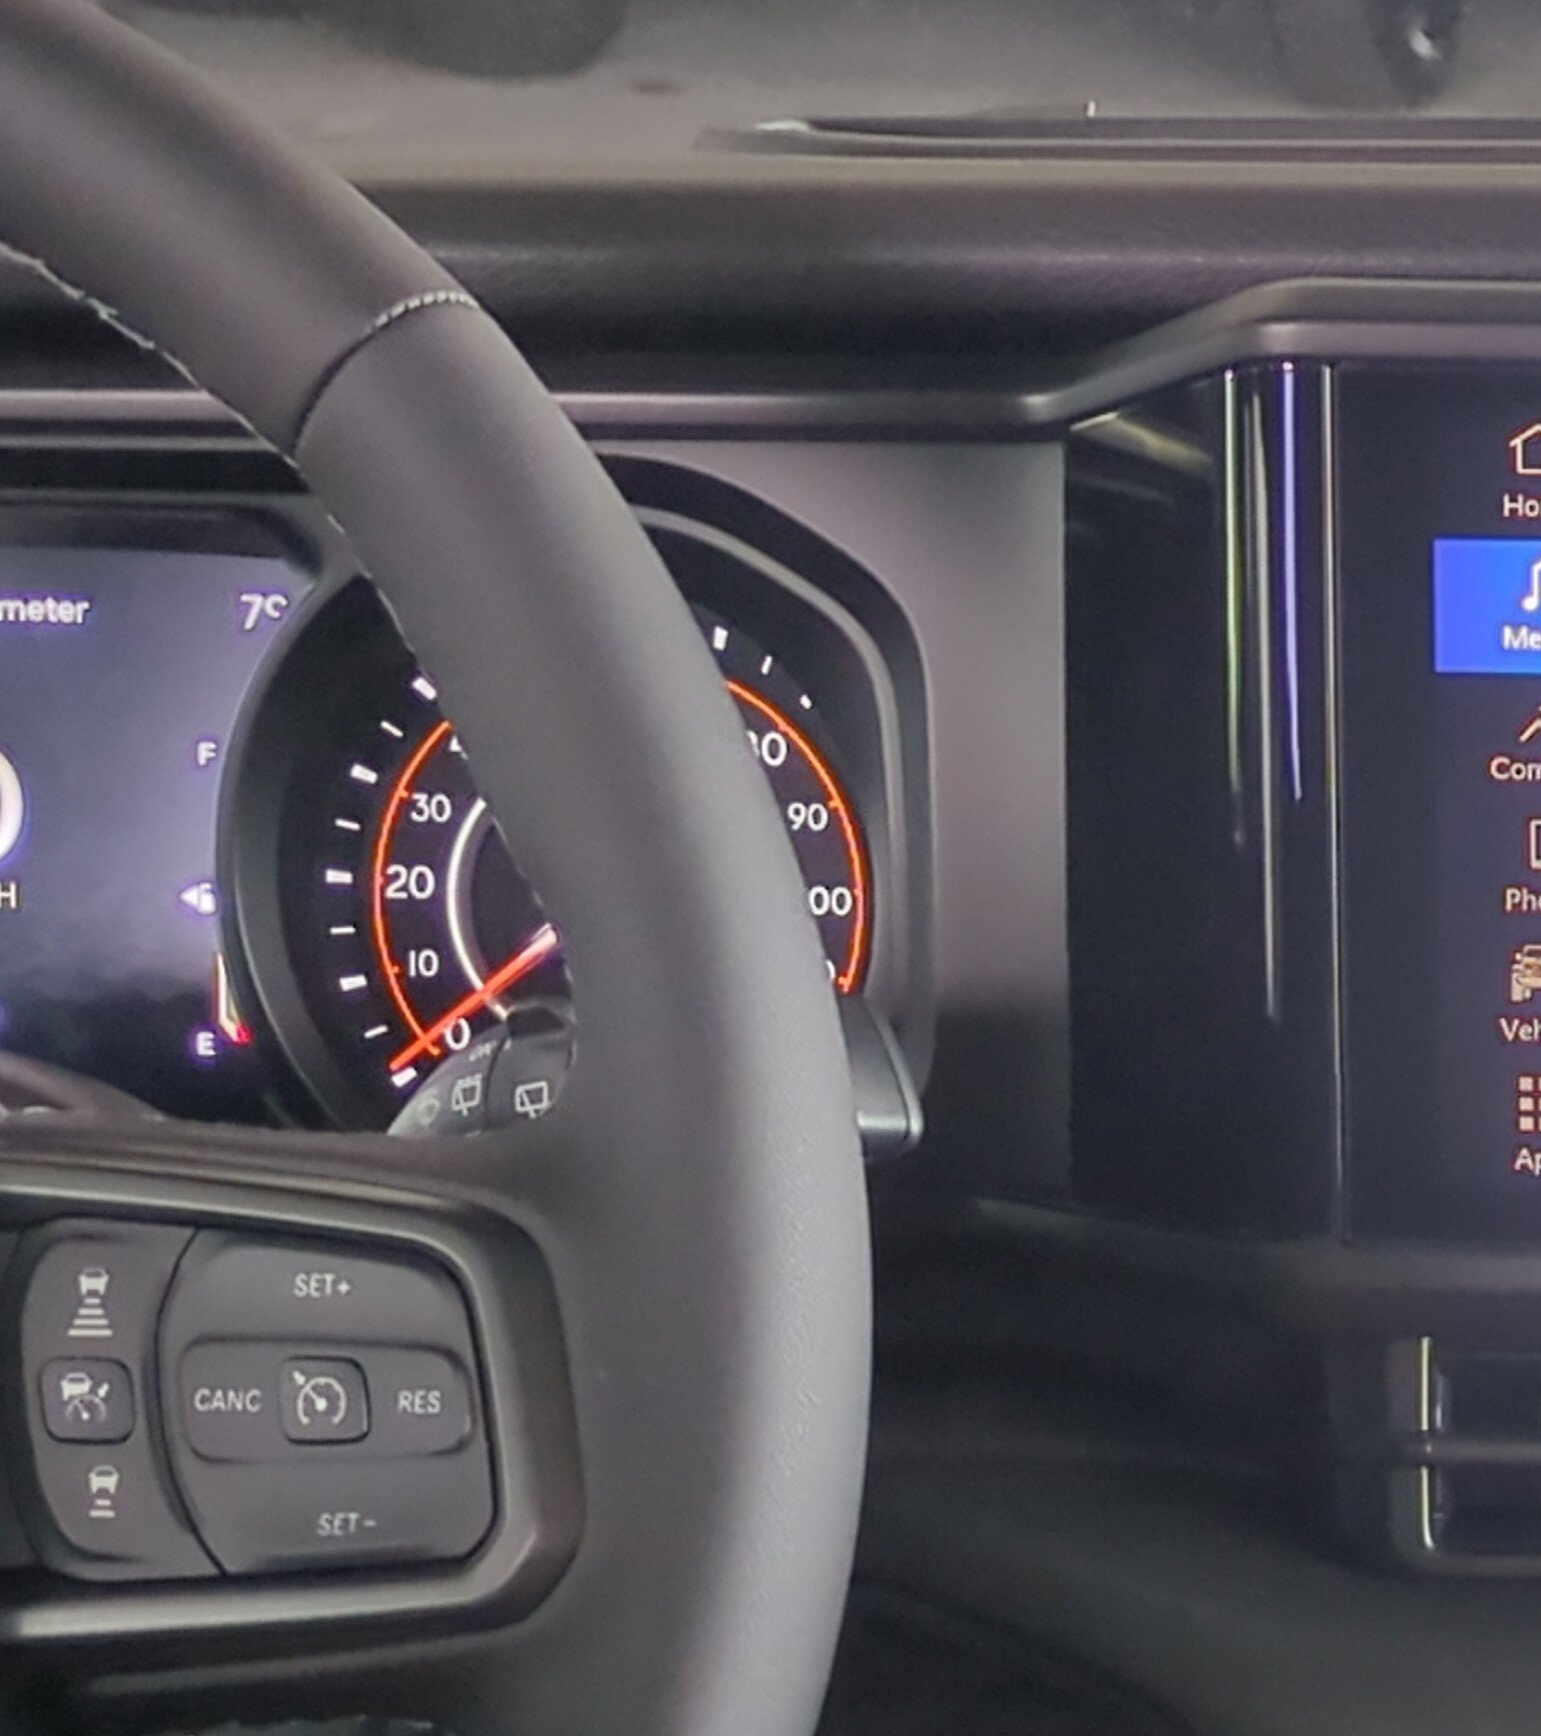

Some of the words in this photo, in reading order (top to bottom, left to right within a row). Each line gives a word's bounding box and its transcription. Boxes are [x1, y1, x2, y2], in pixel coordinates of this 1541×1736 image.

[197, 741, 217, 766] F
[410, 794, 452, 824] 30
[788, 802, 828, 831] 90
[385, 866, 435, 900] 20
[809, 886, 852, 916] 00
[408, 950, 439, 978] 10
[196, 1032, 216, 1056] E
[445, 1017, 471, 1051] 0
[293, 1274, 351, 1297] SET+
[194, 1388, 262, 1412] CANC
[397, 1390, 442, 1413] RES
